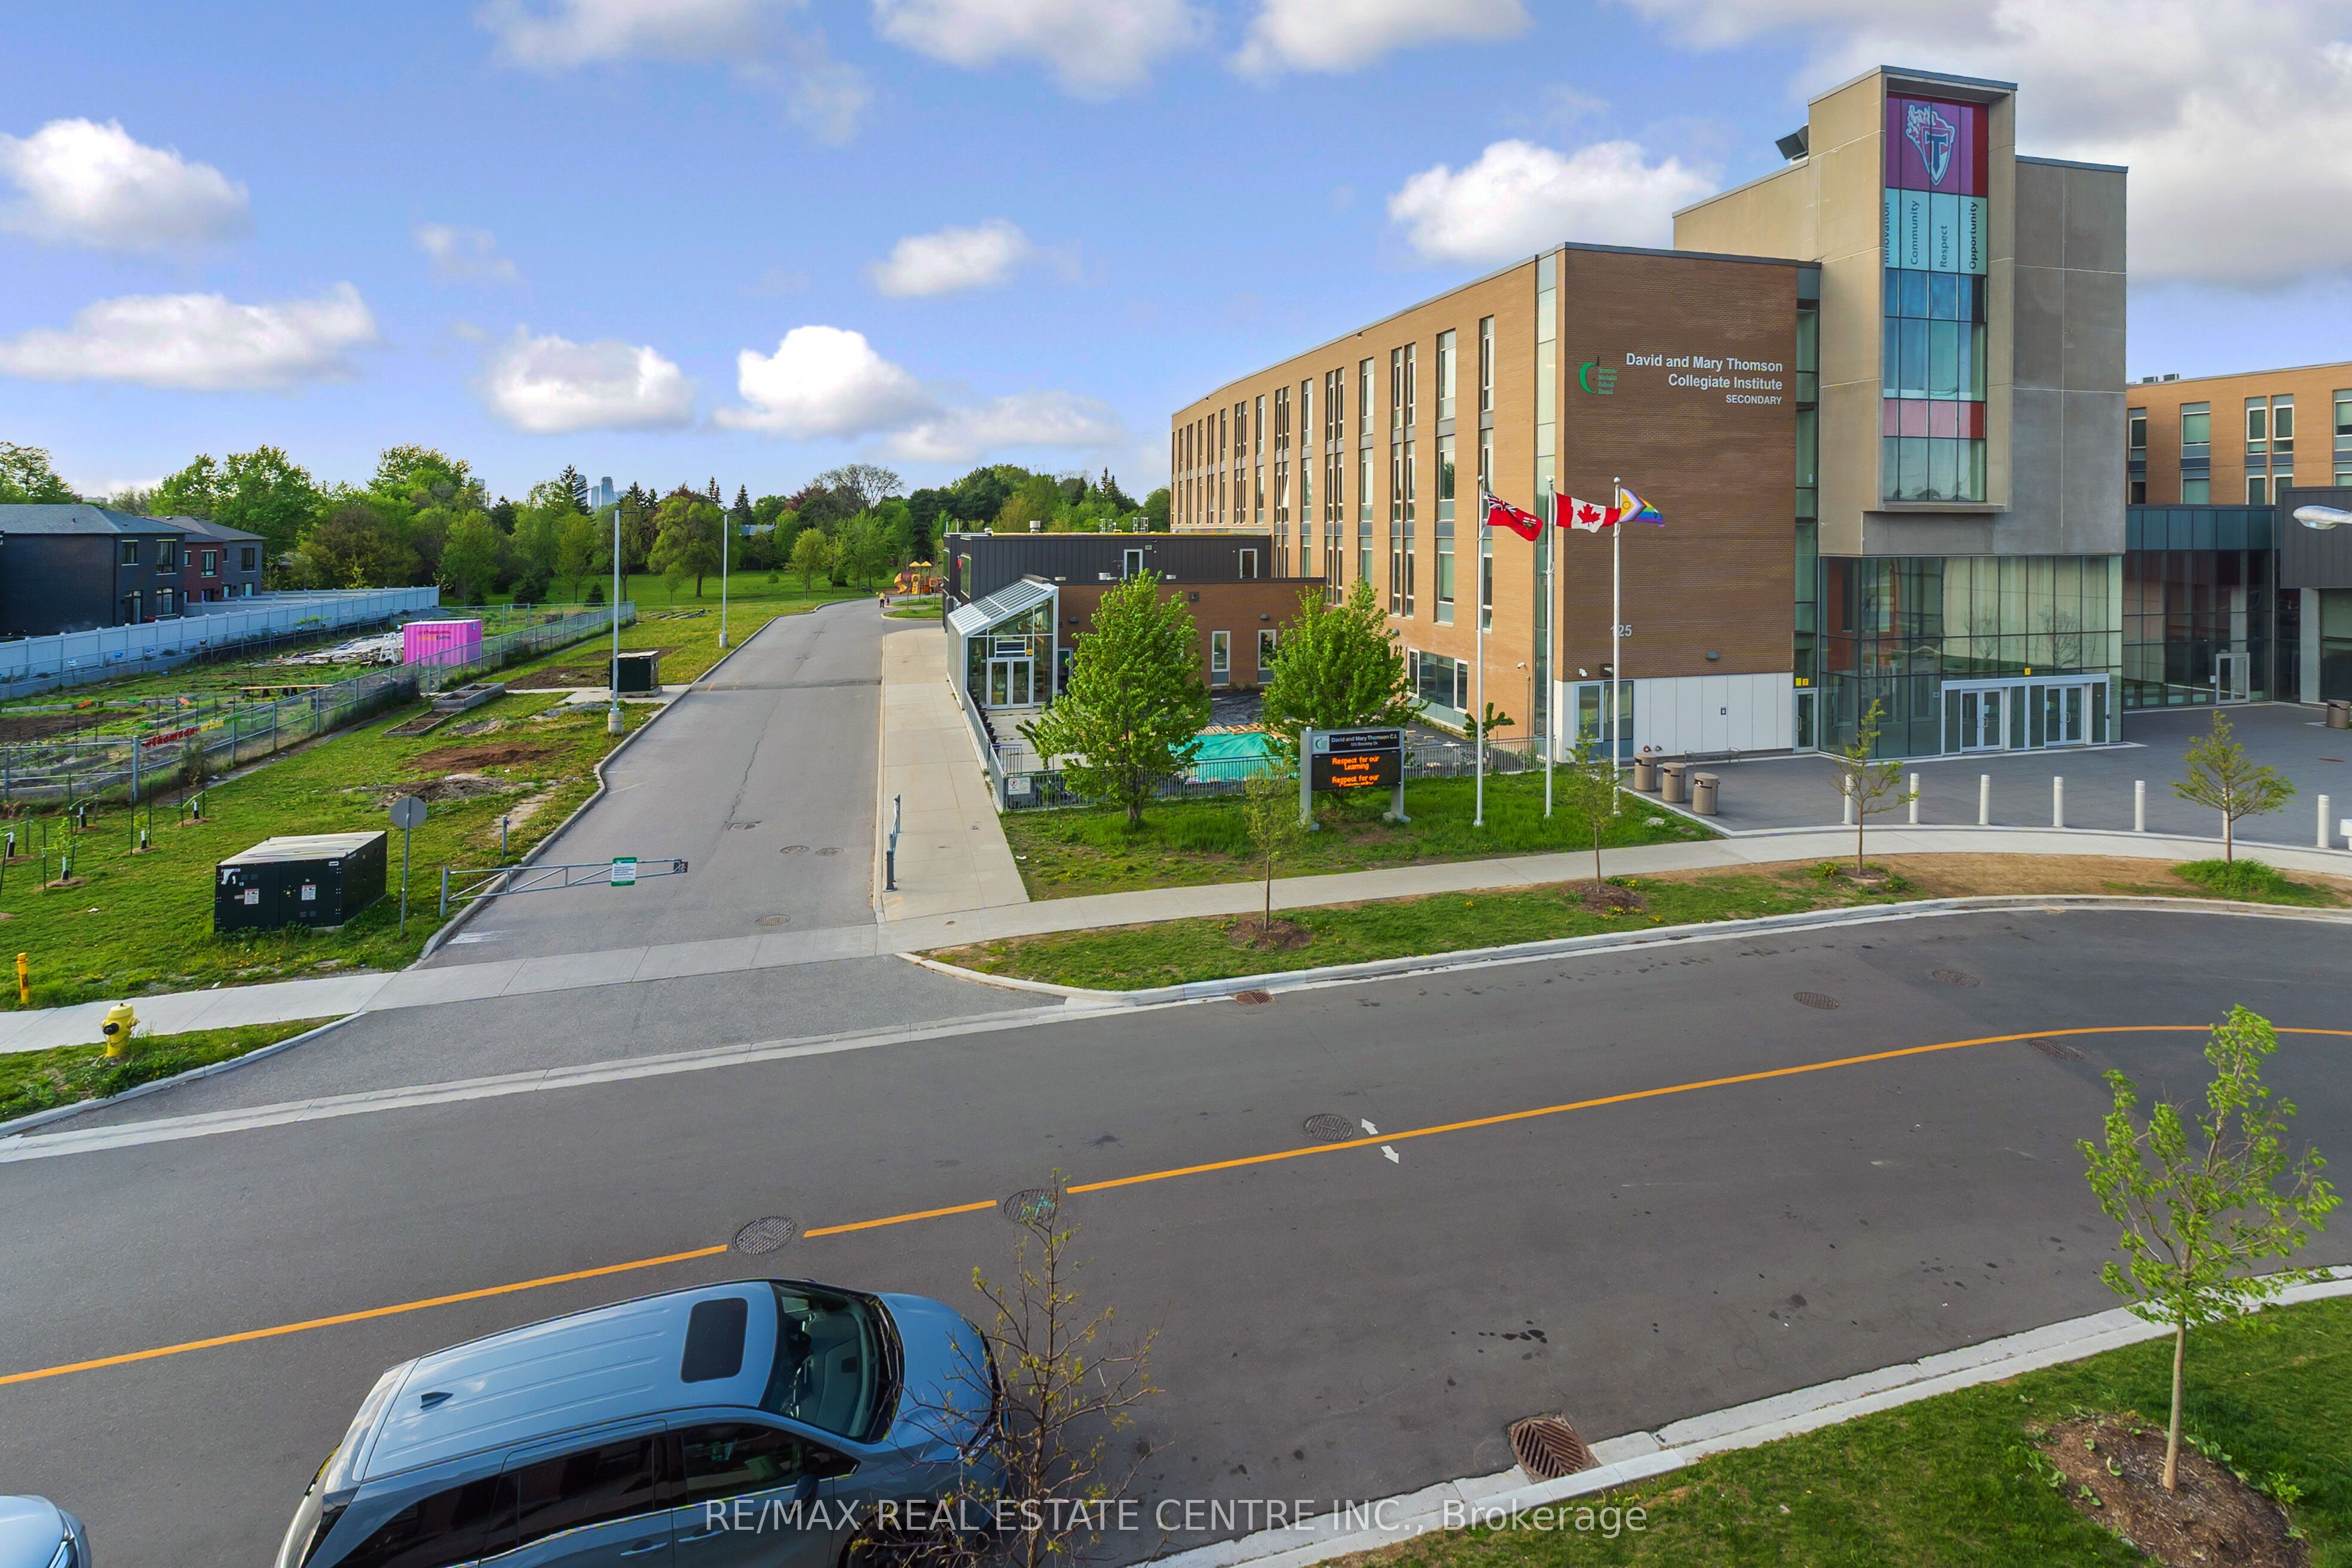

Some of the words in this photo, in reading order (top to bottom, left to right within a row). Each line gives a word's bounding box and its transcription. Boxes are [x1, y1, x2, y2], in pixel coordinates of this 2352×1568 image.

[1910, 200, 1920, 265] Community
[1940, 225, 1949, 268] Respect
[1968, 201, 1979, 270] Opportunity
[1626, 352, 1662, 367] David
[1666, 355, 1689, 368] and
[1693, 356, 1723, 372] Mary
[1726, 357, 1783, 372] Thomson
[1668, 373, 1731, 390] Collegiate
[1734, 376, 1783, 390] Institute
[1726, 394, 1782, 405] SECONDARY
